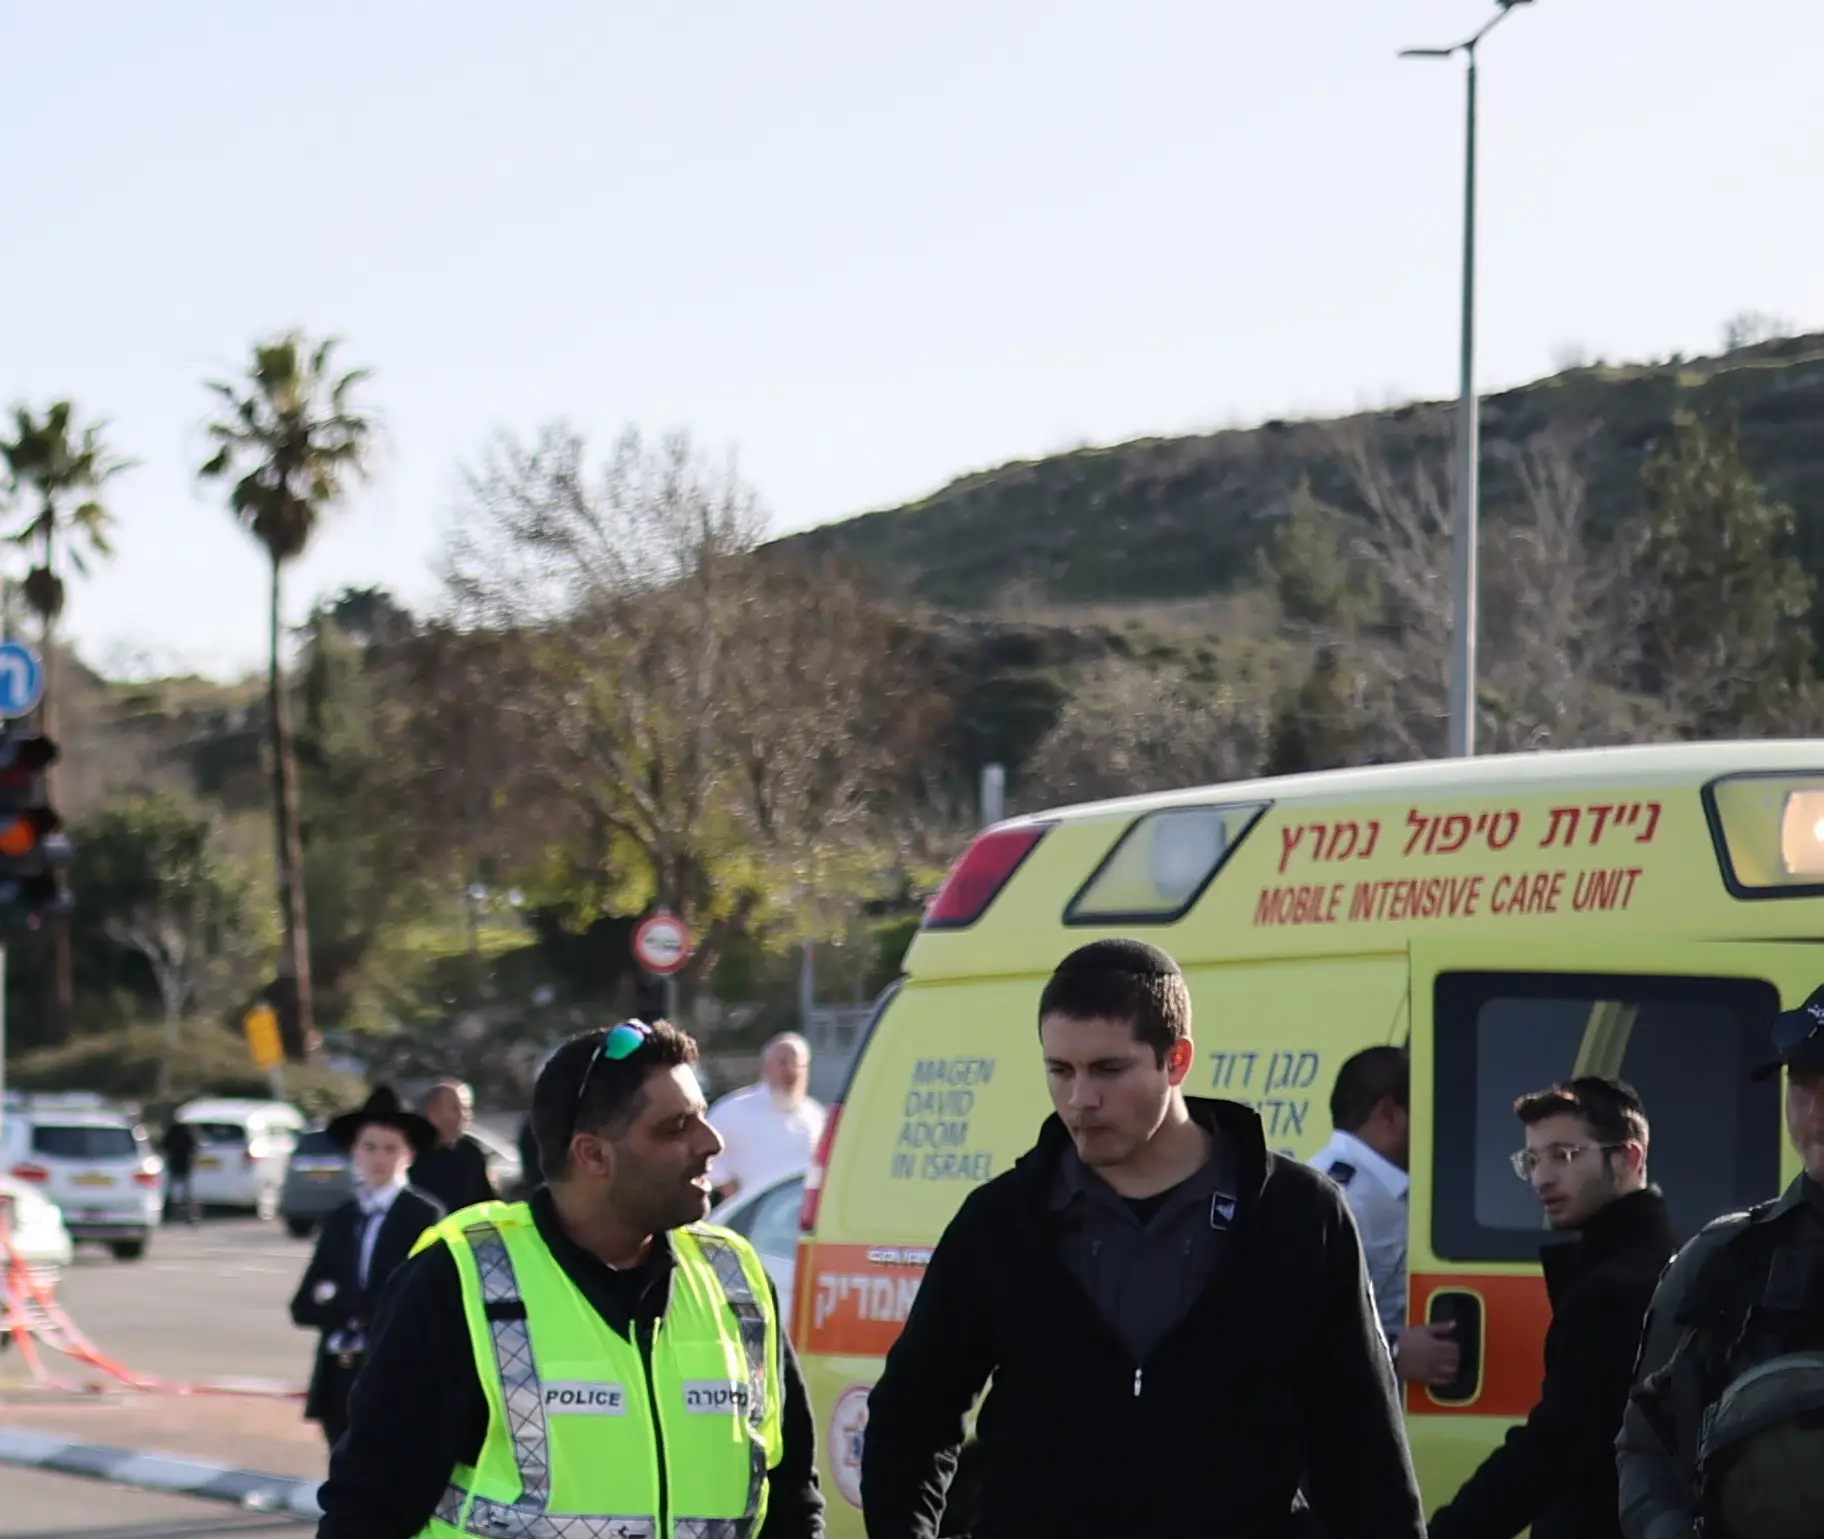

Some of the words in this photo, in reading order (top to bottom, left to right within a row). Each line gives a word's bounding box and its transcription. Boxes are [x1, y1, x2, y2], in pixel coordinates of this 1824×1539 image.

[1403, 806, 1520, 857] טיפול
[1539, 801, 1662, 850] ניידת
[1278, 820, 1381, 875] נמרץ
[1253, 883, 1345, 928] MOBILE
[1348, 876, 1485, 922] INTENSIVE
[1490, 872, 1567, 915] CARE
[1572, 868, 1643, 912] UNIT
[913, 1058, 995, 1086] MAGEN
[1210, 1052, 1259, 1089] דוד
[1265, 1051, 1319, 1095] מגן
[905, 1089, 975, 1117] DAVID
[899, 1122, 969, 1148] ADOM
[891, 1153, 915, 1179] IN
[545, 1389, 621, 1407] POLICE
